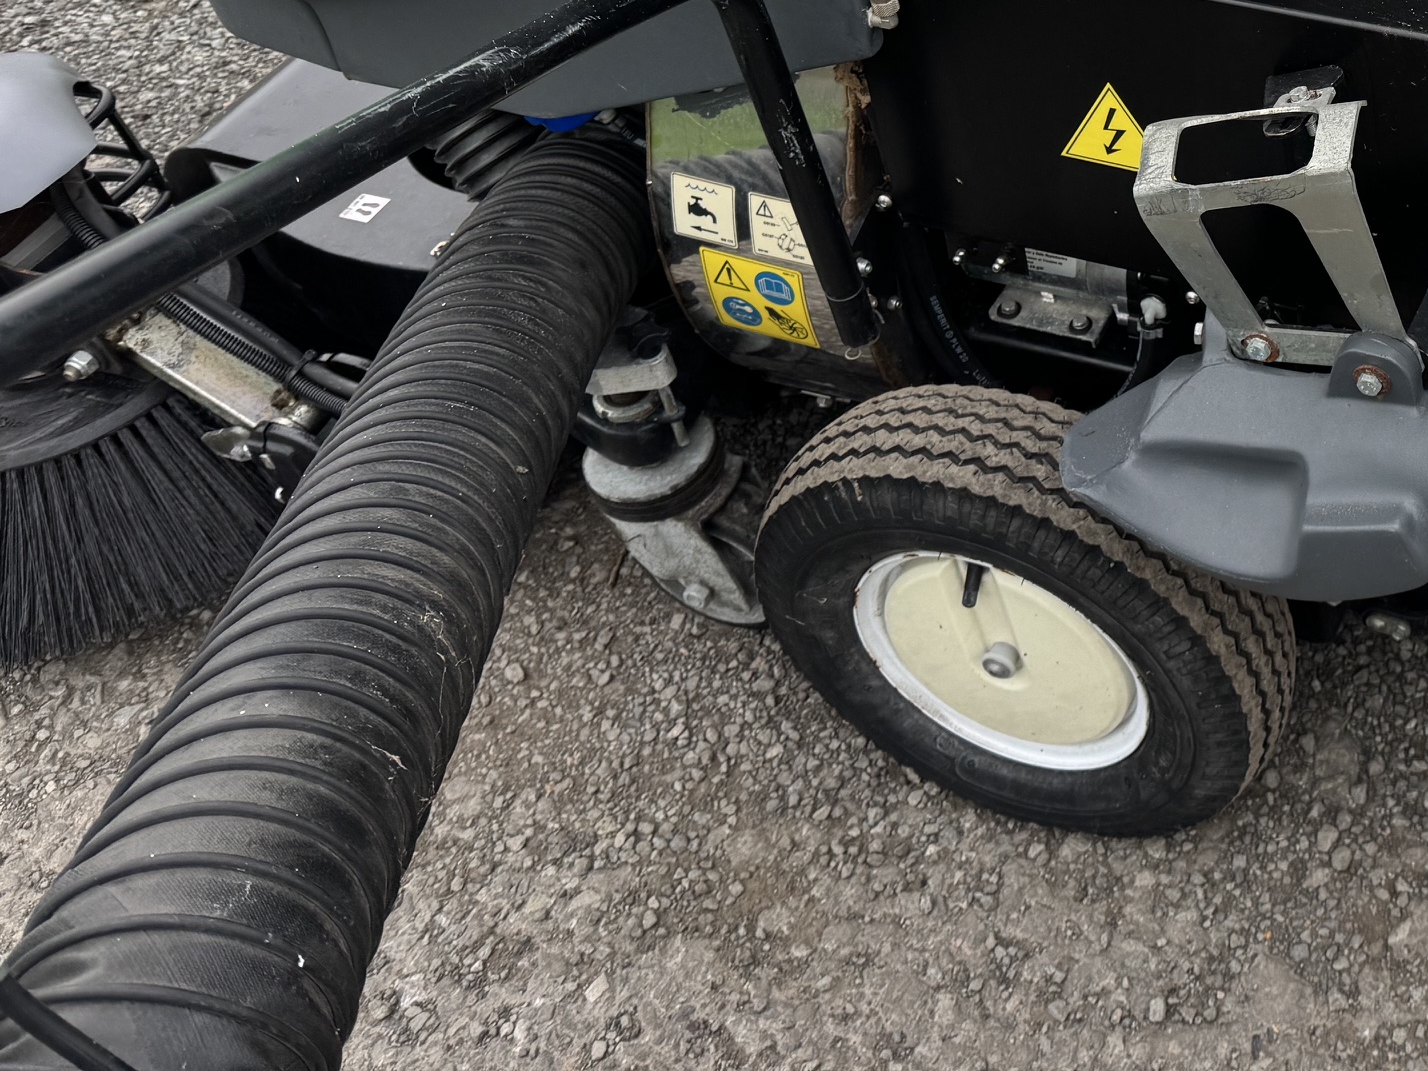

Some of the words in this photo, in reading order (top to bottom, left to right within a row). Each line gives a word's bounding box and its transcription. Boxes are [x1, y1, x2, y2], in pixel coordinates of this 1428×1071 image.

[929, 295, 951, 331] SEMPERIT
[949, 338, 965, 354] PLW
[959, 352, 969, 363] 20
